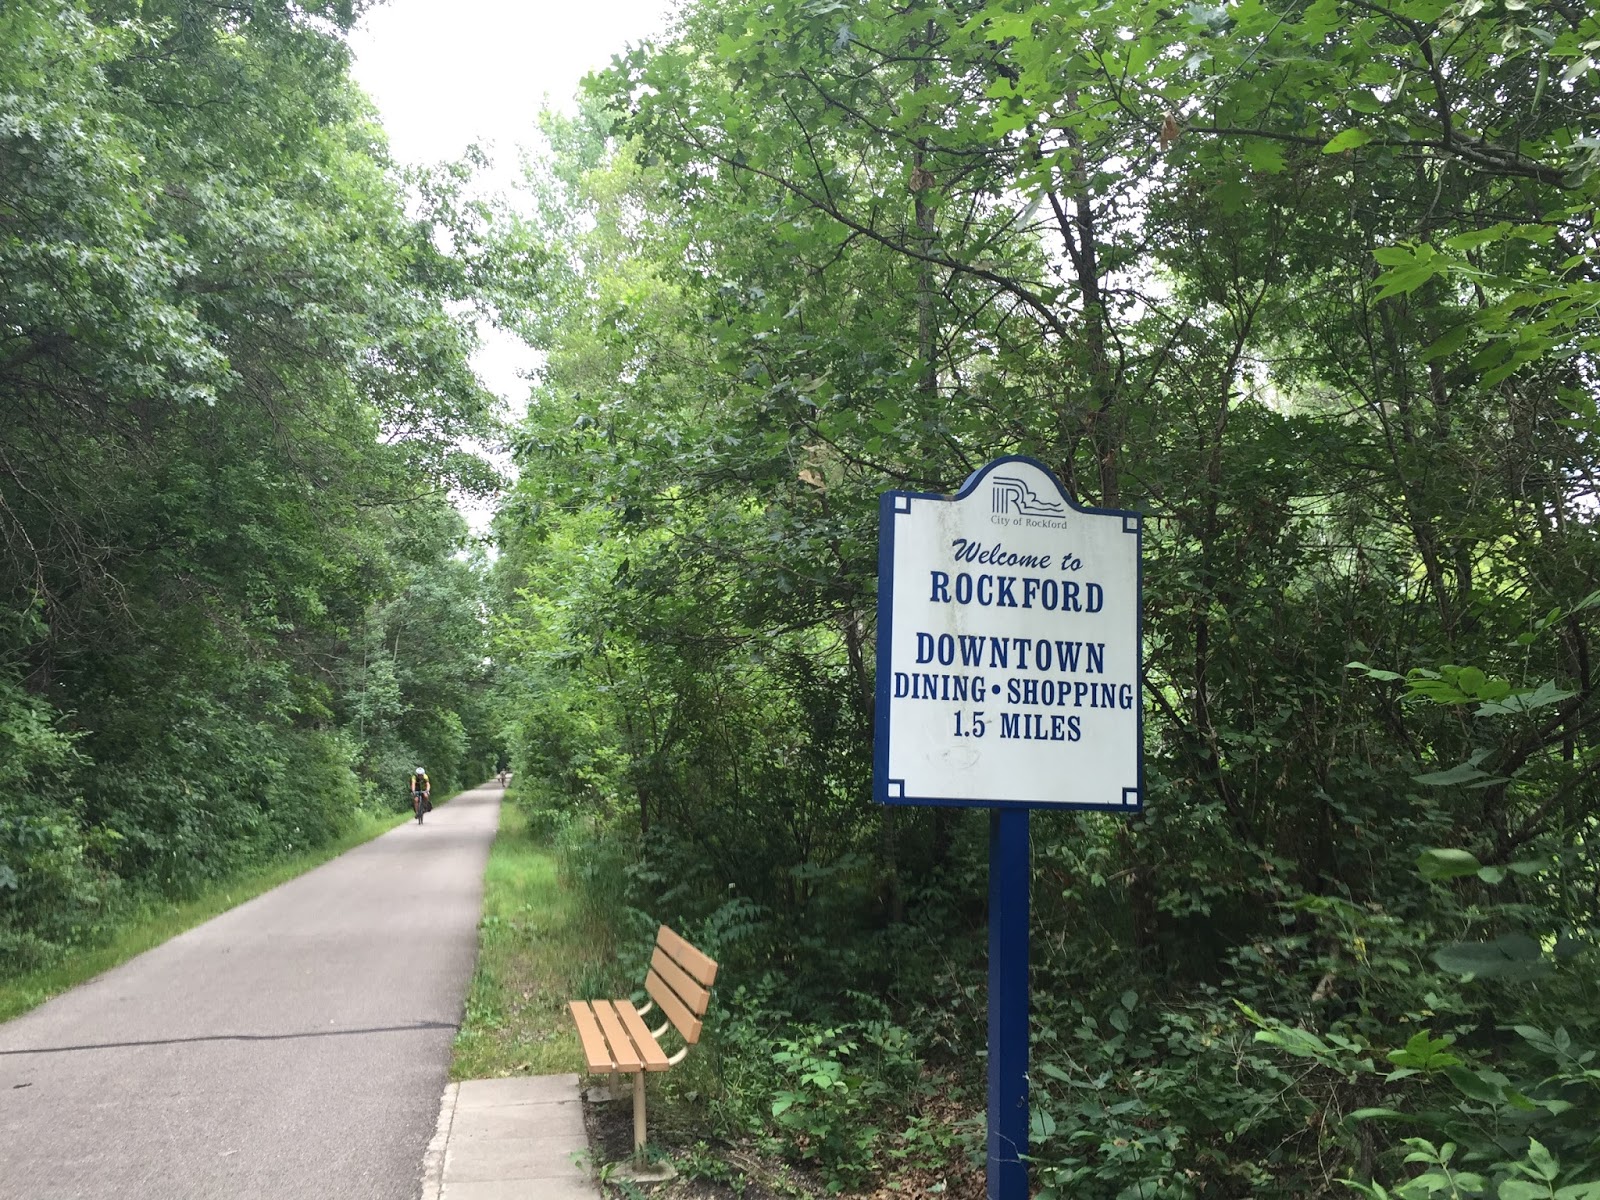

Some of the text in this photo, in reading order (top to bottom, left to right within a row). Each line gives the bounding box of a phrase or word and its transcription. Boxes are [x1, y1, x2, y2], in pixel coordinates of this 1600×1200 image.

[990, 515, 1068, 530] City of Rockford
[951, 538, 1084, 572] Welcome to
[929, 570, 1104, 614] ROCKFORD
[915, 631, 1106, 675] DOWNTOWN
[893, 671, 1134, 710] DINING SHOPPING
[953, 710, 1082, 743] 1.5 MILES
